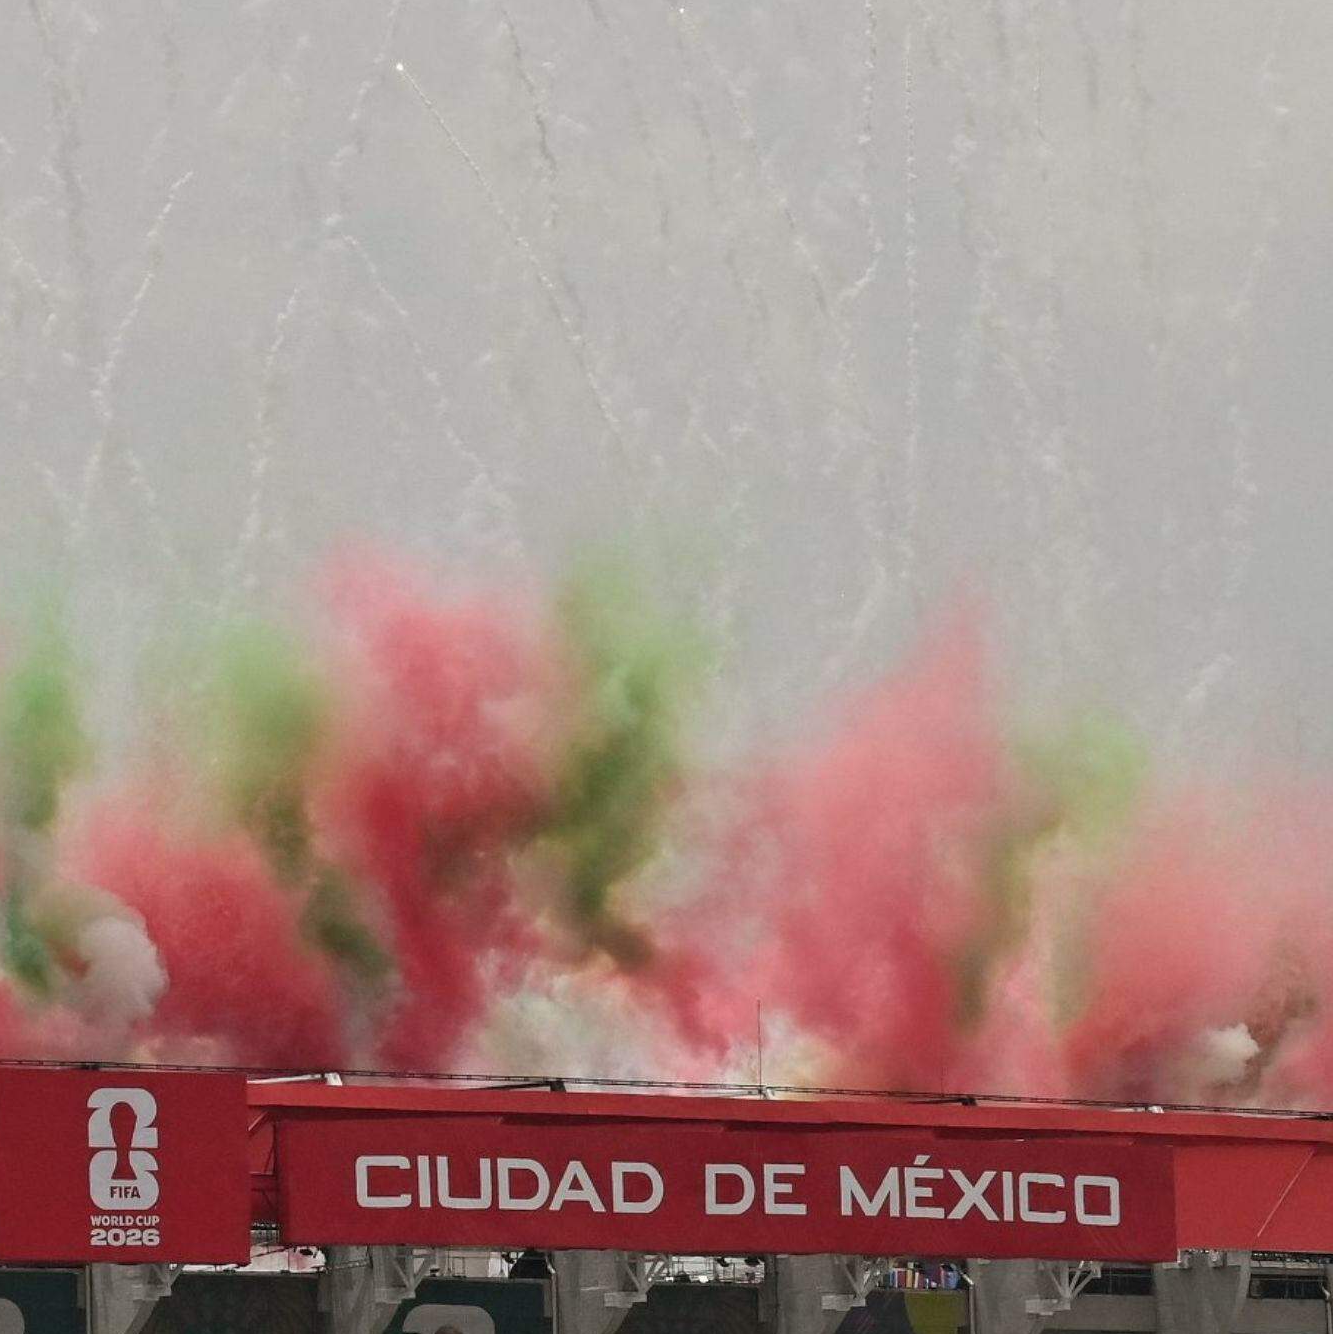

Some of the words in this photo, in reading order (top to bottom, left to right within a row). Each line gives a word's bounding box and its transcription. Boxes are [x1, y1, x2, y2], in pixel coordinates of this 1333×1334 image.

[109, 1186, 141, 1199] FIFA
[355, 1155, 665, 1214] CIUDAD
[704, 1162, 808, 1215] DE
[839, 1154, 1121, 1227] MÉXICO
[90, 1215, 134, 1226] WORLD
[135, 1215, 160, 1226] CUP
[90, 1228, 160, 1247] 2026
